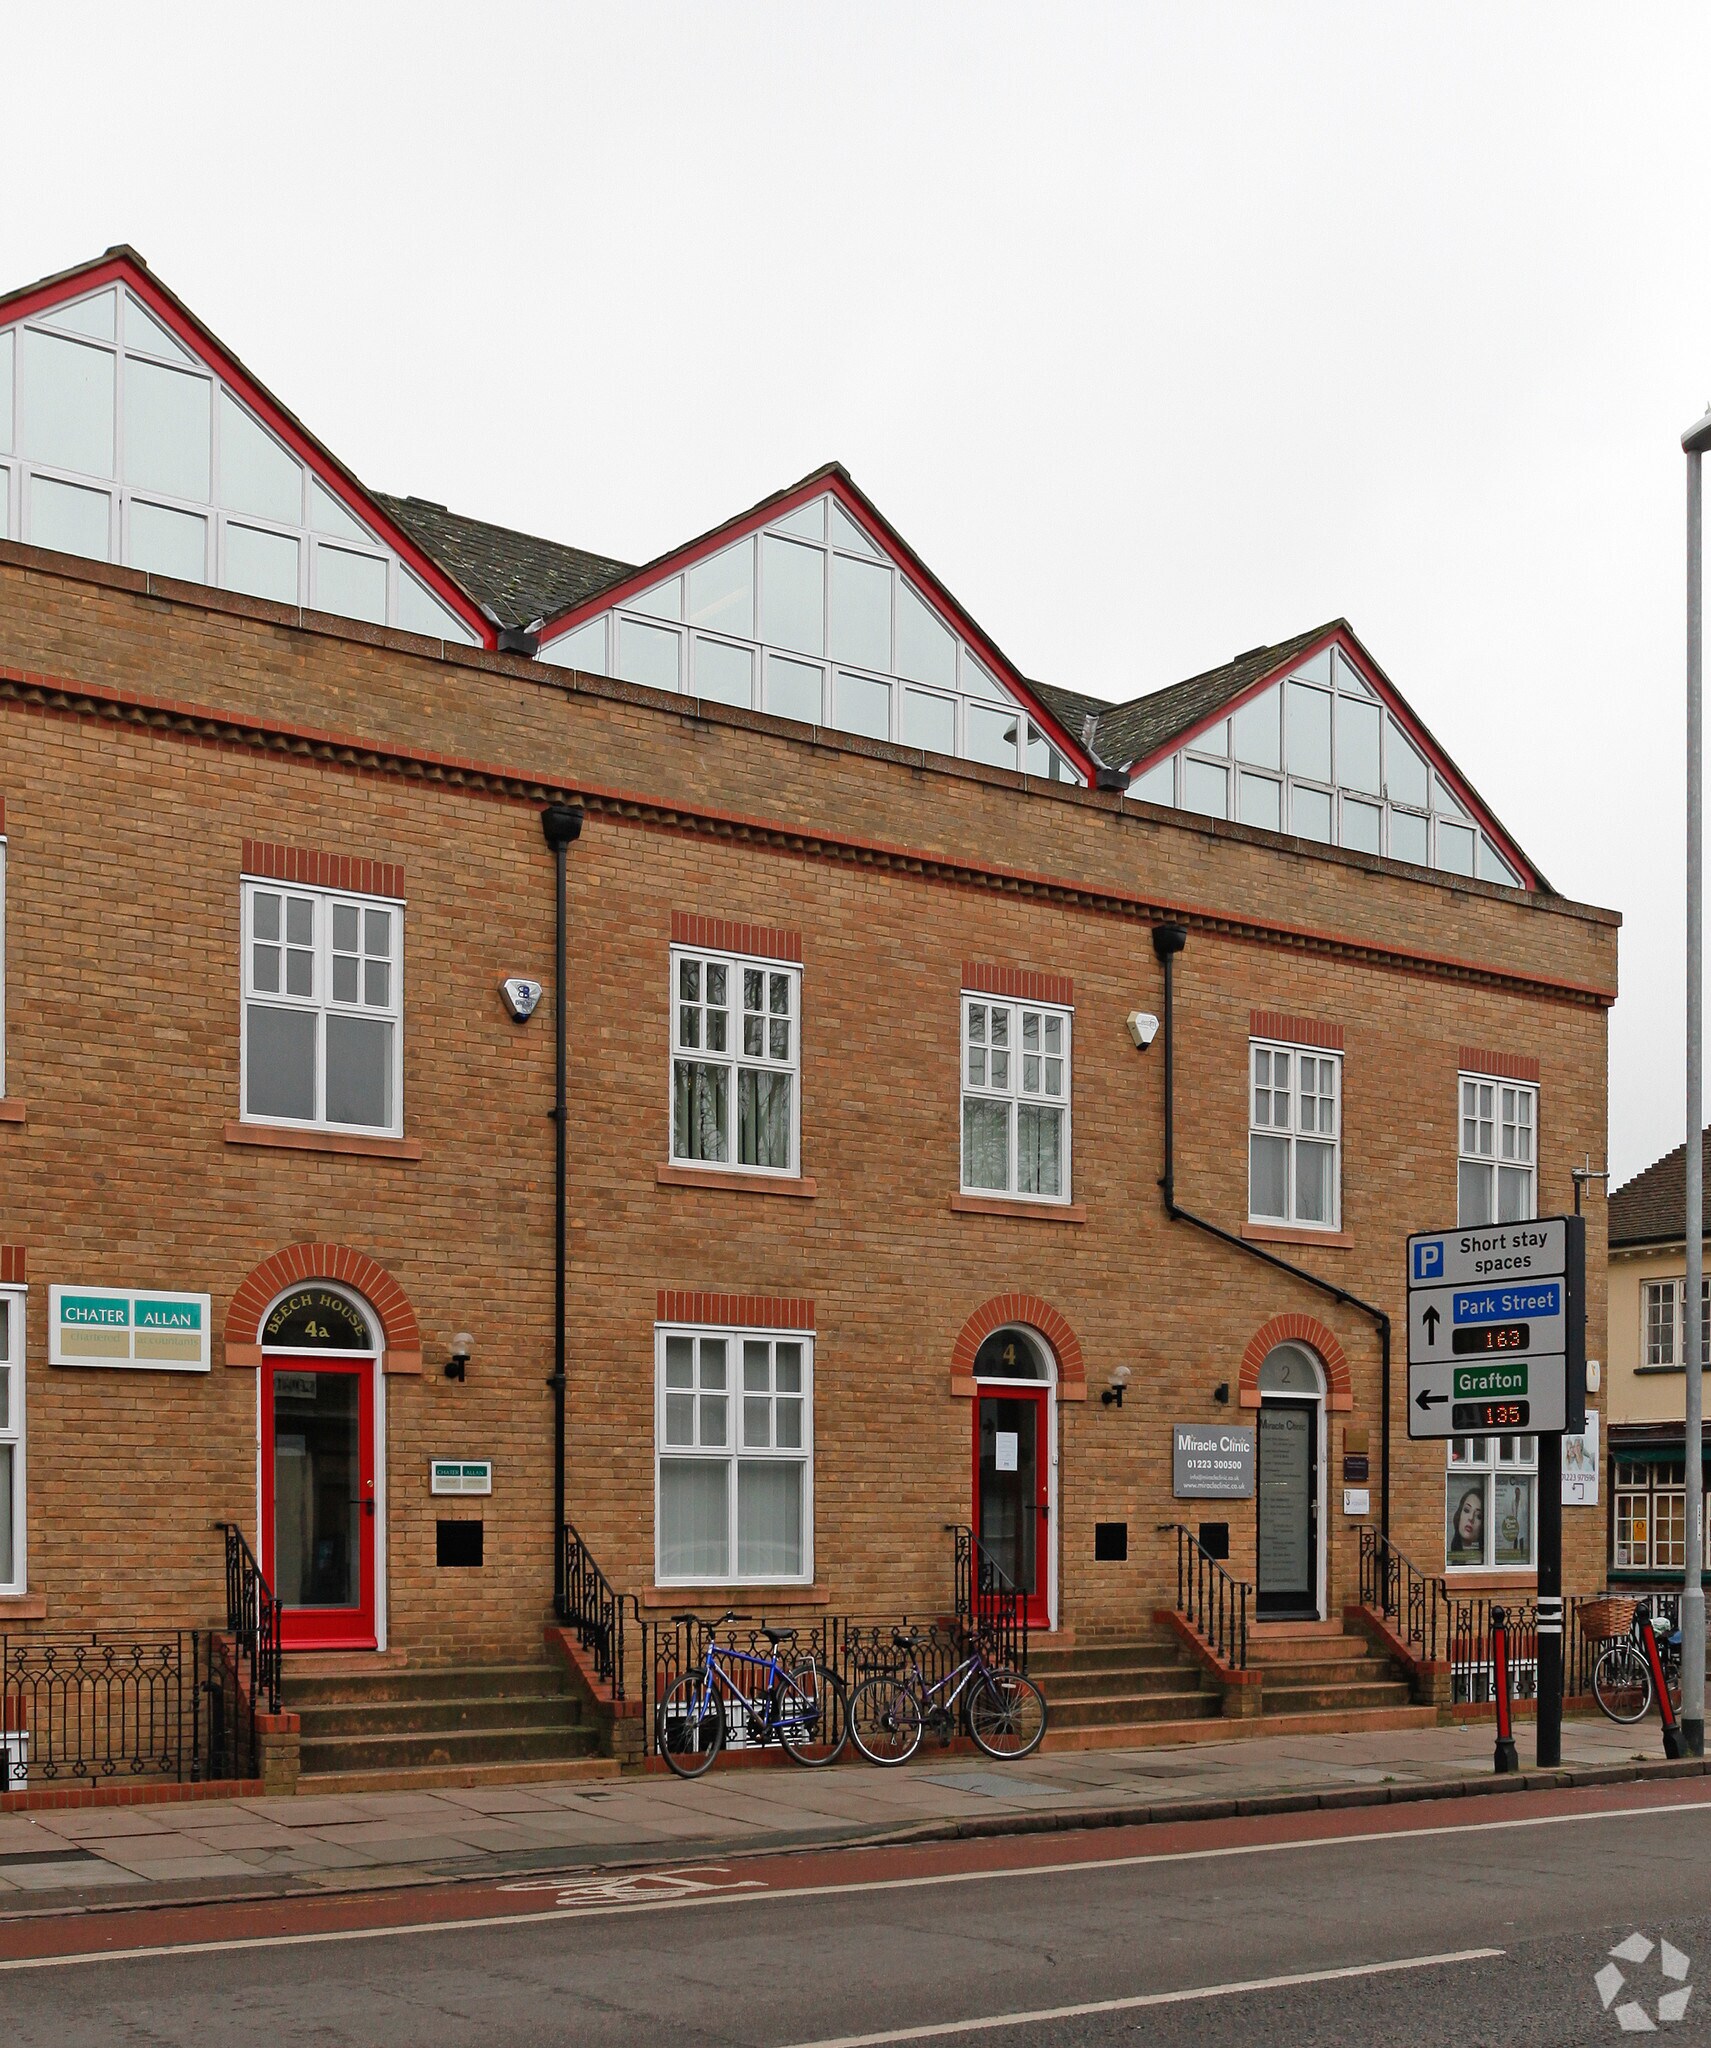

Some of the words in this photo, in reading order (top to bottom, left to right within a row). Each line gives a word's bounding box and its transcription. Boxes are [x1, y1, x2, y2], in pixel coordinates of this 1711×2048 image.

[1460, 1234, 1506, 1253] Short
[1513, 1232, 1548, 1248] stay
[1420, 1245, 1438, 1276] P
[1475, 1255, 1532, 1274] spaces
[1459, 1297, 1495, 1315] Park
[1501, 1291, 1554, 1311] Street
[65, 1307, 125, 1323] CHATER
[143, 1312, 191, 1326] ALLAN
[267, 1294, 313, 1335] BEECH
[319, 1294, 366, 1336] HOUSE
[70, 1331, 121, 1342] chartered
[137, 1335, 199, 1346] accountants
[304, 1320, 330, 1338] 4a
[1486, 1329, 1520, 1348] 163
[1002, 1343, 1016, 1365] 4
[1281, 1365, 1291, 1384] 2
[1459, 1372, 1522, 1391] Grafton
[1486, 1406, 1520, 1425] 135
[1178, 1434, 1217, 1452] Miracle
[1220, 1436, 1250, 1452] Clinic
[1187, 1460, 1212, 1469] 01223
[1213, 1460, 1242, 1469] 300500
